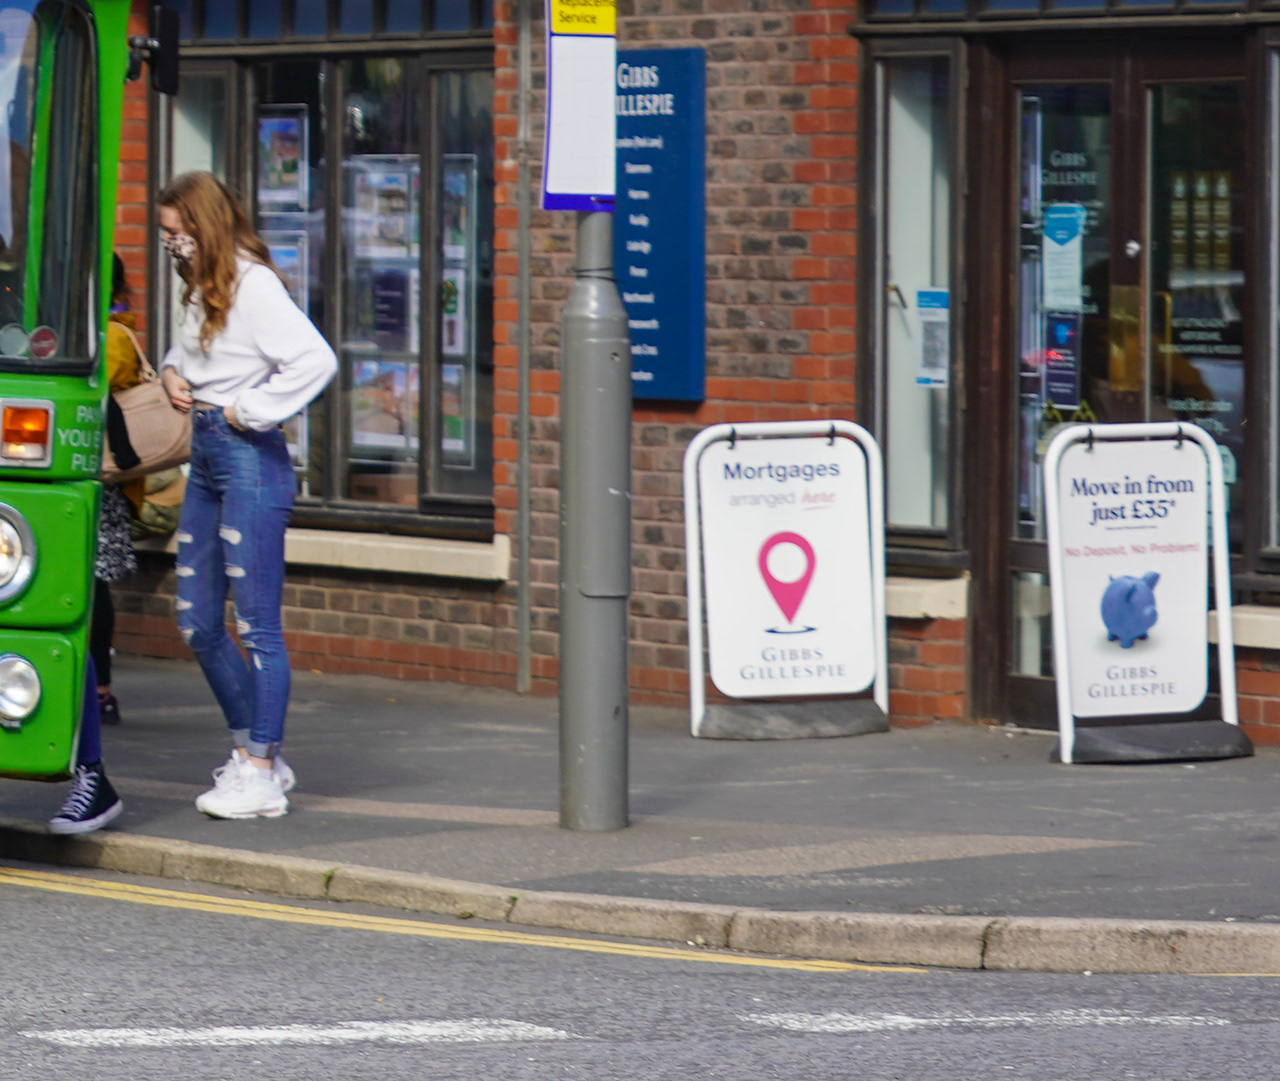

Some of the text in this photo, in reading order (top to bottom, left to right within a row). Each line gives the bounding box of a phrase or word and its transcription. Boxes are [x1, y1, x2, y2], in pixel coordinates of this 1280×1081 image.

[559, 10, 597, 24] Service
[617, 63, 661, 89] GIBBS
[616, 93, 675, 116] ILLESPIE
[57, 427, 91, 447] YOU
[723, 462, 840, 482] Mortgages
[1070, 474, 1194, 497] Move in from
[729, 490, 795, 508] arranged
[1089, 501, 1126, 526] just
[1064, 546, 1081, 557] No
[1131, 544, 1146, 555] No
[761, 646, 824, 662] GIBBS
[740, 664, 847, 680] GILLESPIE
[1106, 665, 1158, 680] GIBBS
[1088, 683, 1176, 699] GILLESPIE
